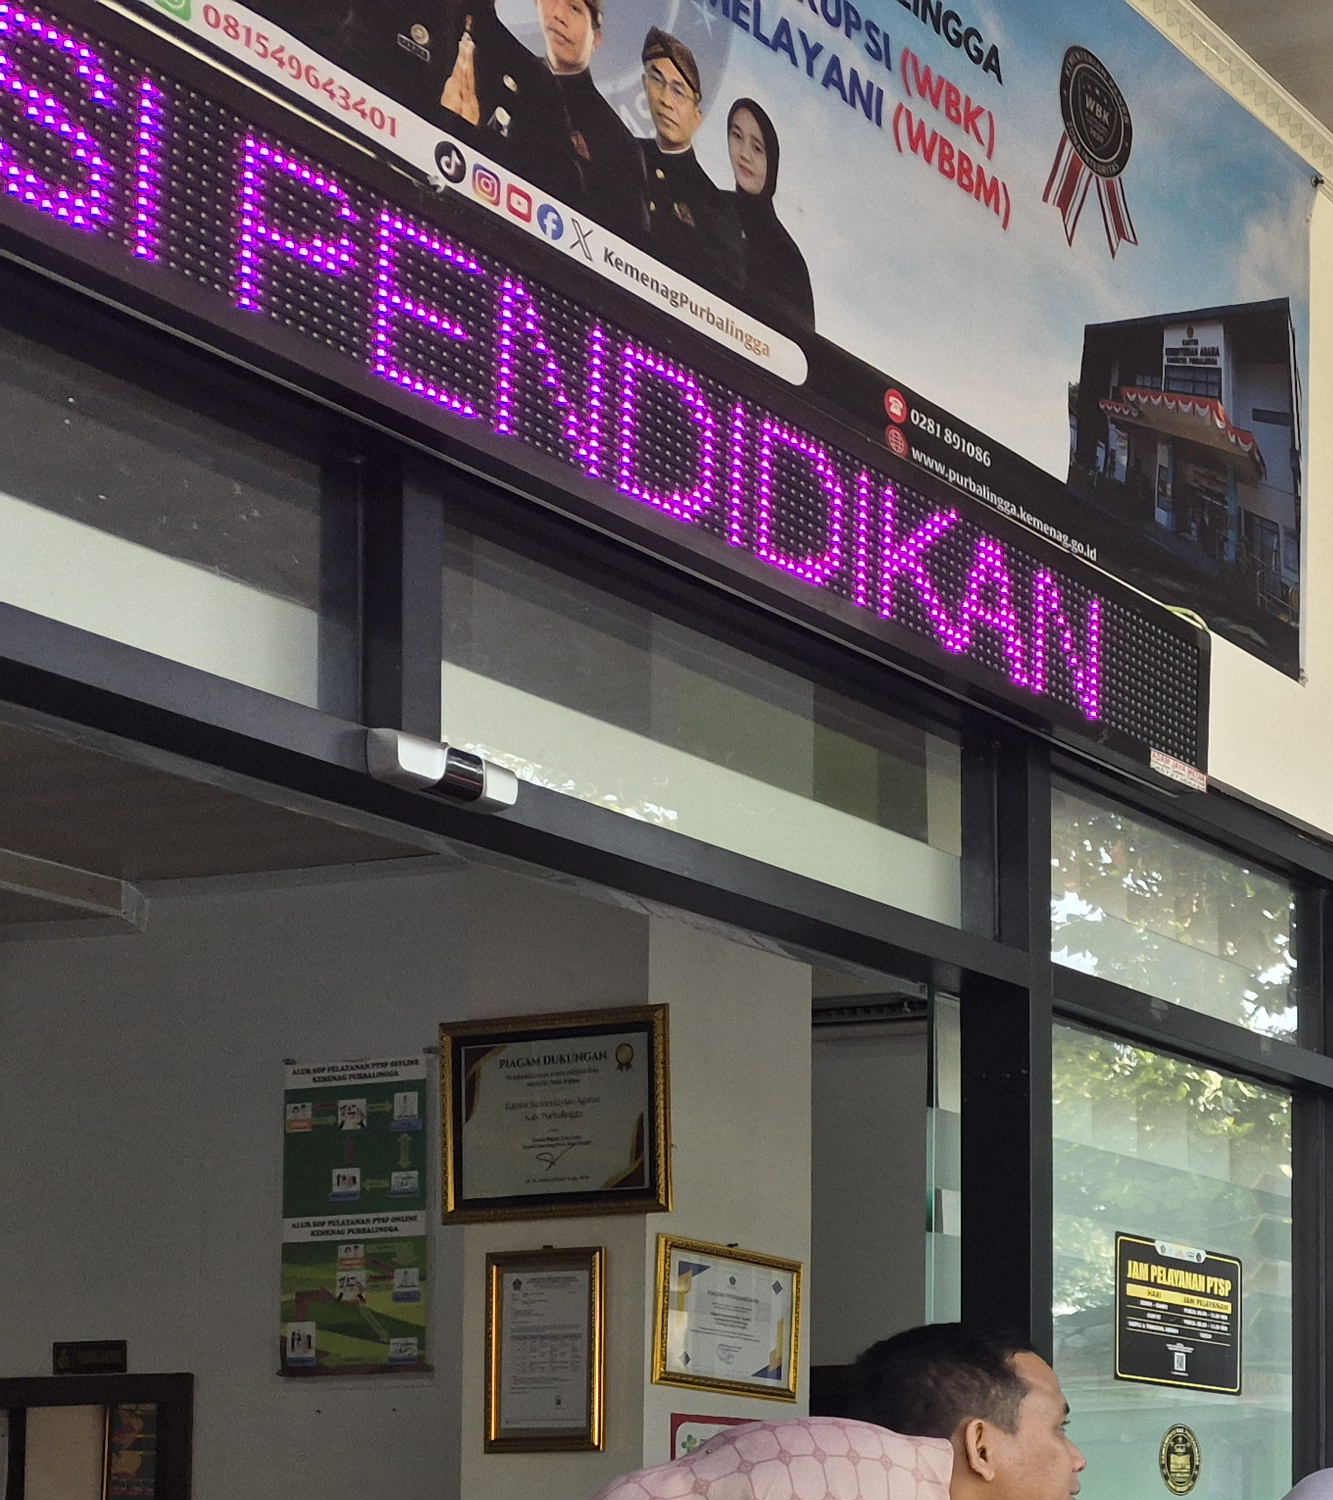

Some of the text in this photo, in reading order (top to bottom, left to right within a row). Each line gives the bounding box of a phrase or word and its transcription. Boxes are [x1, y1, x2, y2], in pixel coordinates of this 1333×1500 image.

[202, 3, 398, 139] 081549643401
[898, 0, 1004, 86] INGGA
[901, 47, 995, 161] (WBK)
[1085, 93, 1111, 126] WBK
[893, 101, 1011, 231] (WBBM)
[603, 246, 771, 359] KemenagPurbalingga
[238, 135, 1101, 721] PENDIDIKAN
[909, 407, 992, 468] 0281 891086
[911, 446, 1098, 562] www.purbalingga.kemenag.go.id
[498, 1050, 608, 1070] PIAGAM DUKUNGAN
[1127, 1259, 1232, 1298] JAM PELAYANAN PTSP
